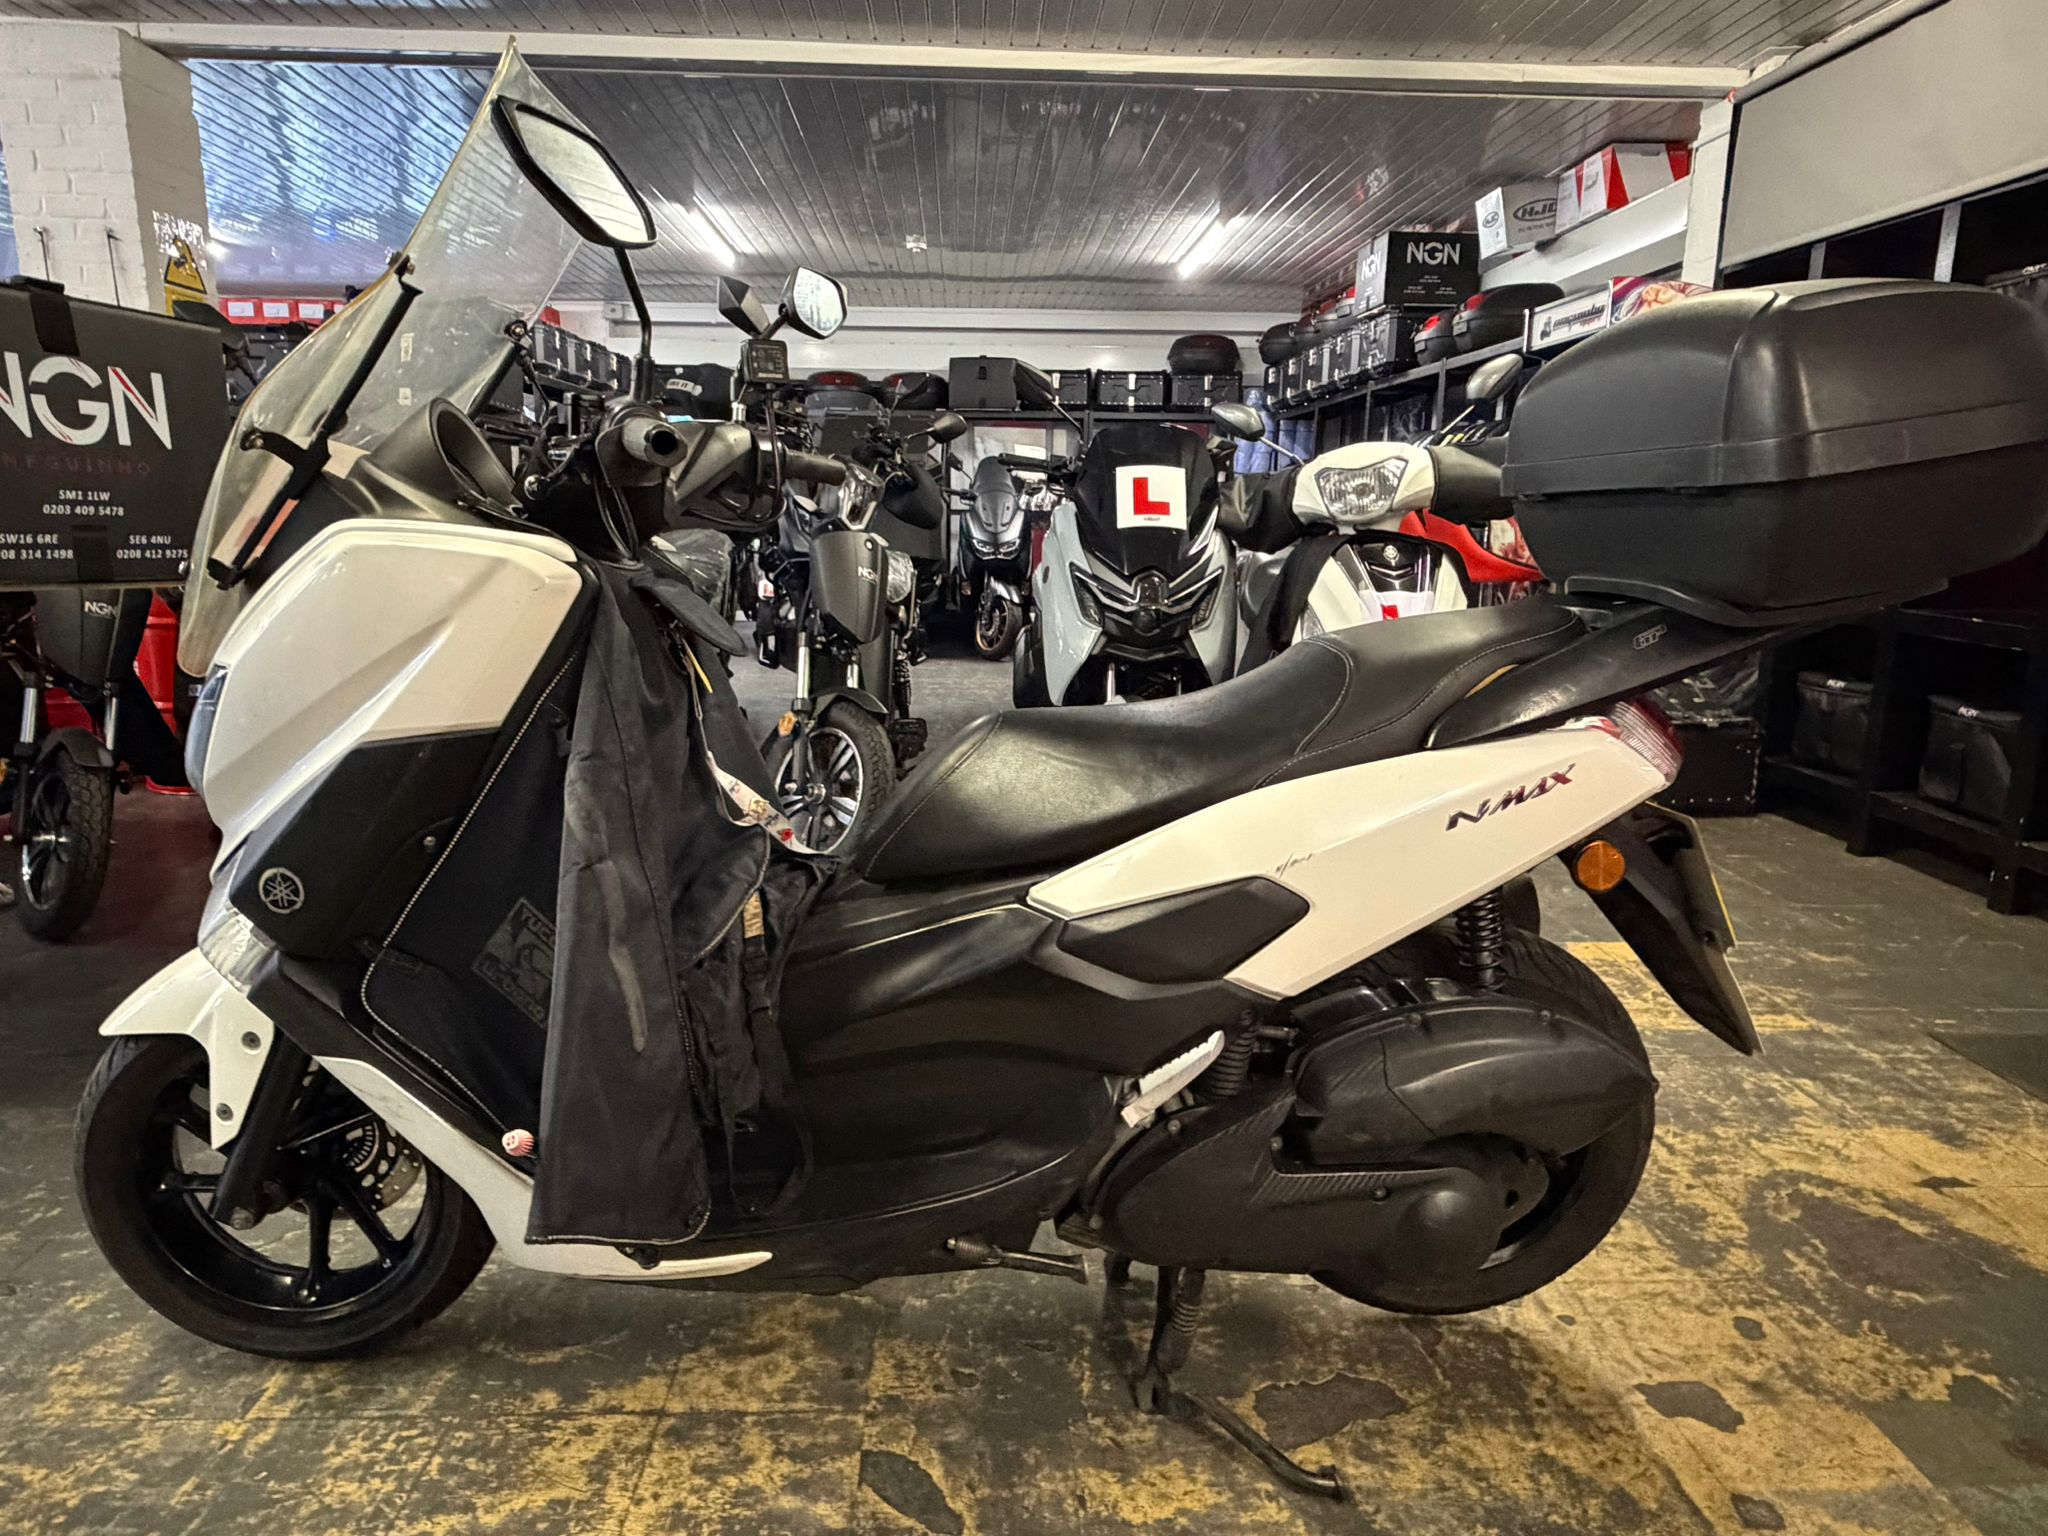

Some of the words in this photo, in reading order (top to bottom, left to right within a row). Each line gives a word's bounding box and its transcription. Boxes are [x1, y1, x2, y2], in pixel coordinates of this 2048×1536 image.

[1406, 241, 1461, 266] NGN
[1361, 250, 1382, 281] NGN
[0, 351, 173, 450] NGN
[58, 489, 84, 500] SM1
[87, 490, 111, 501] 1LW
[1132, 477, 1171, 516] L
[42, 504, 71, 515] 0203
[74, 505, 95, 515] 409
[99, 505, 125, 516] 5478
[0, 533, 33, 545] SW16
[36, 533, 59, 545] 6RE
[129, 534, 147, 545] SE6
[150, 534, 172, 545] 4NU
[20, 549, 42, 560] 314
[46, 549, 74, 560] 1498
[116, 549, 142, 559] 0208
[144, 549, 163, 559] 412
[165, 549, 189, 560] 9275
[83, 600, 118, 616] NGN
[1445, 762, 1577, 832] NMAX
